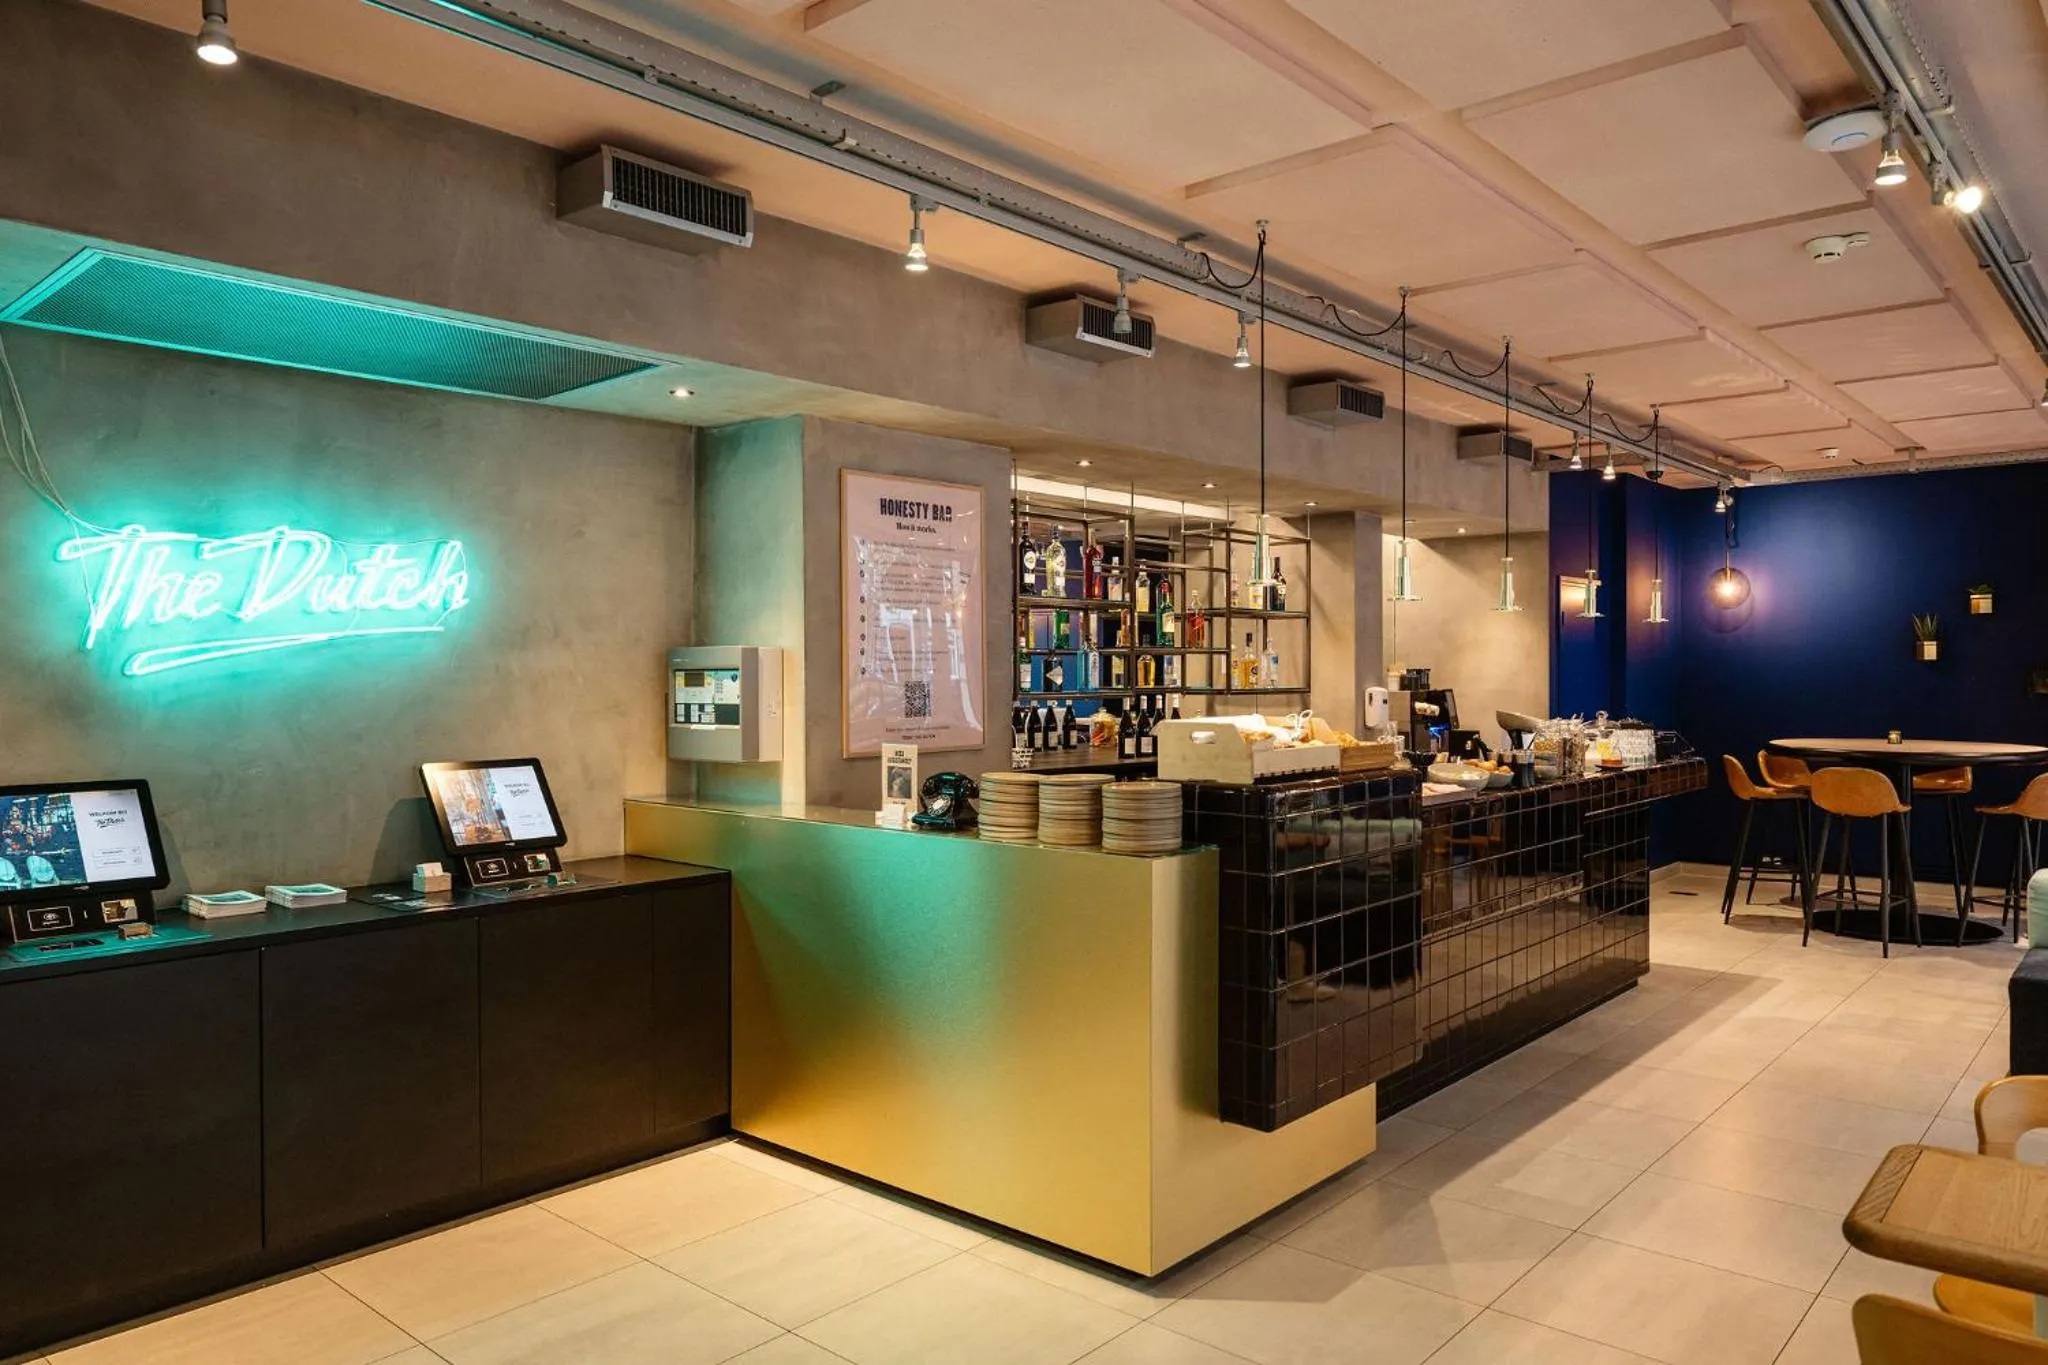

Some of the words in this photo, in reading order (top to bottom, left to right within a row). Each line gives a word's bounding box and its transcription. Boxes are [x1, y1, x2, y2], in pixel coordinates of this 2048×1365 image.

[880, 498, 929, 518] HONESTY
[932, 504, 952, 521] BAR
[56, 525, 223, 649] The
[200, 526, 470, 622] Dutch
